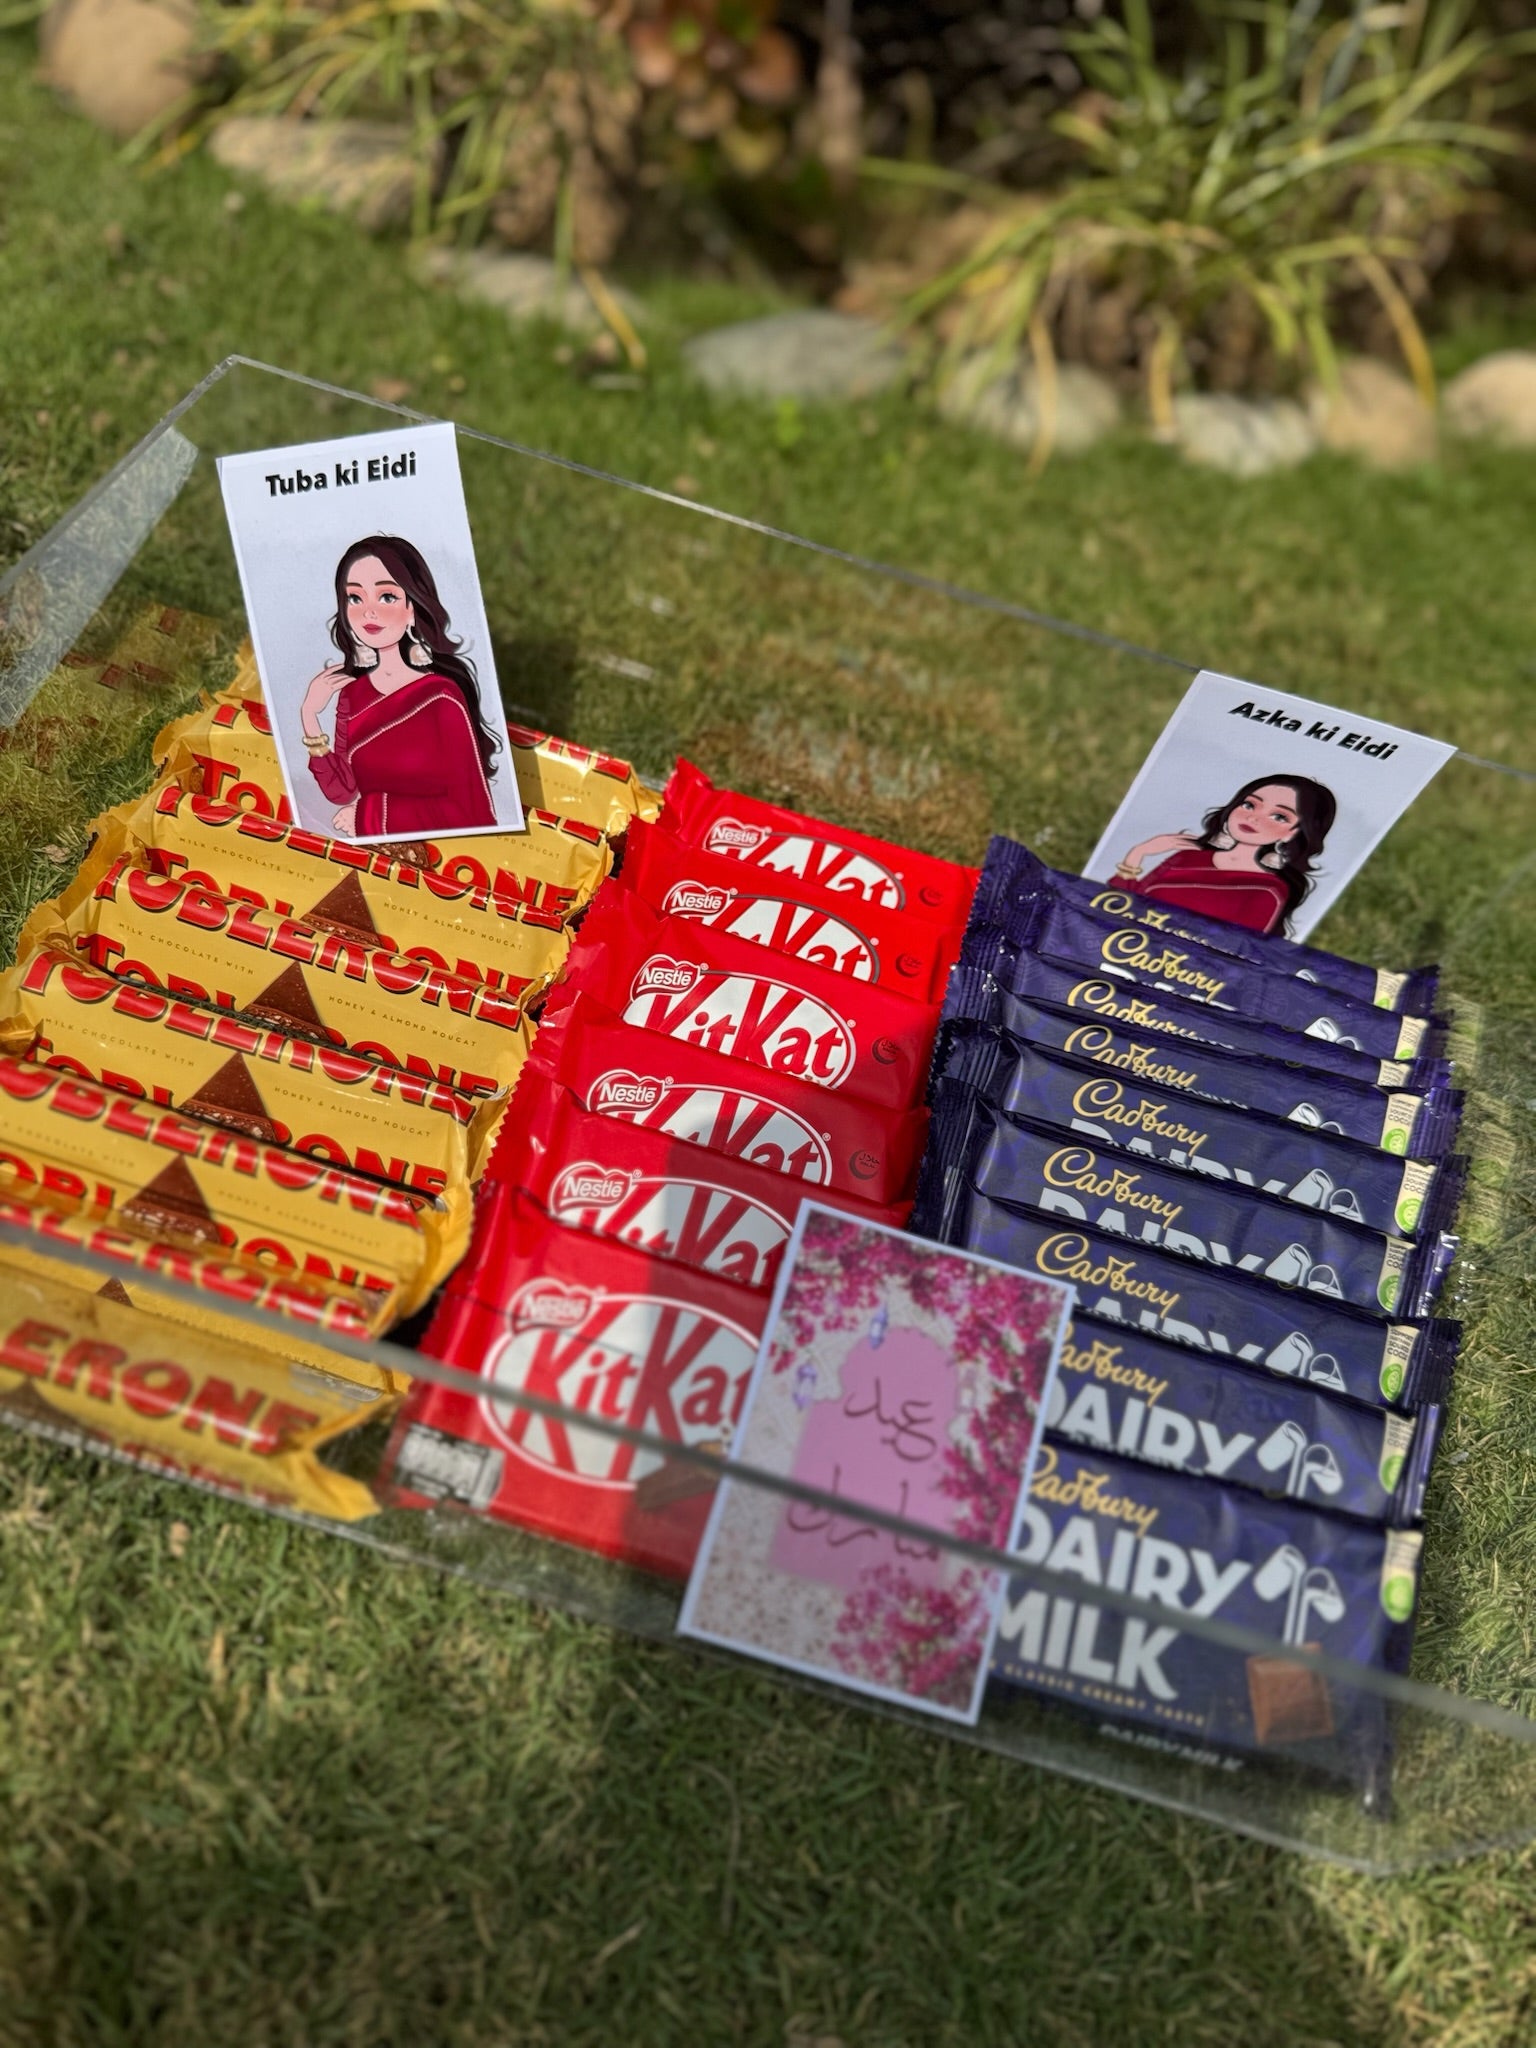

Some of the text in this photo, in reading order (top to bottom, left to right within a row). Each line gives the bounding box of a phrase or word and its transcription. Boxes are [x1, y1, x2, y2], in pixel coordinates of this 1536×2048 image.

[265, 452, 417, 497] Tuba ki Eidi
[1228, 701, 1399, 761] Azka ki Eidi
[179, 836, 315, 883] MILK CHOCOLATE WITH
[118, 922, 255, 976] MILK CHOCOLATE WITH
[383, 901, 420, 917] HONEY
[434, 918, 476, 937] ALMOND
[481, 932, 524, 951] NOUGAT
[1102, 928, 1227, 1003] Cadbury
[82, 1027, 157, 1056] CHOCOLATE
[165, 1053, 195, 1068] WITH
[328, 995, 366, 1012] HONEY
[382, 1013, 427, 1033] ALMOND
[432, 1029, 478, 1048] NOUGAT
[274, 1086, 311, 1103] HONEY
[330, 1104, 378, 1123] ALMOND
[383, 1119, 432, 1138] NOUGAT
[1072, 1078, 1208, 1157] Cadbury
[1042, 1146, 1183, 1230] Cadbury
[1035, 1232, 1181, 1319] Cadbury
[1059, 1321, 1168, 1408] adbury
